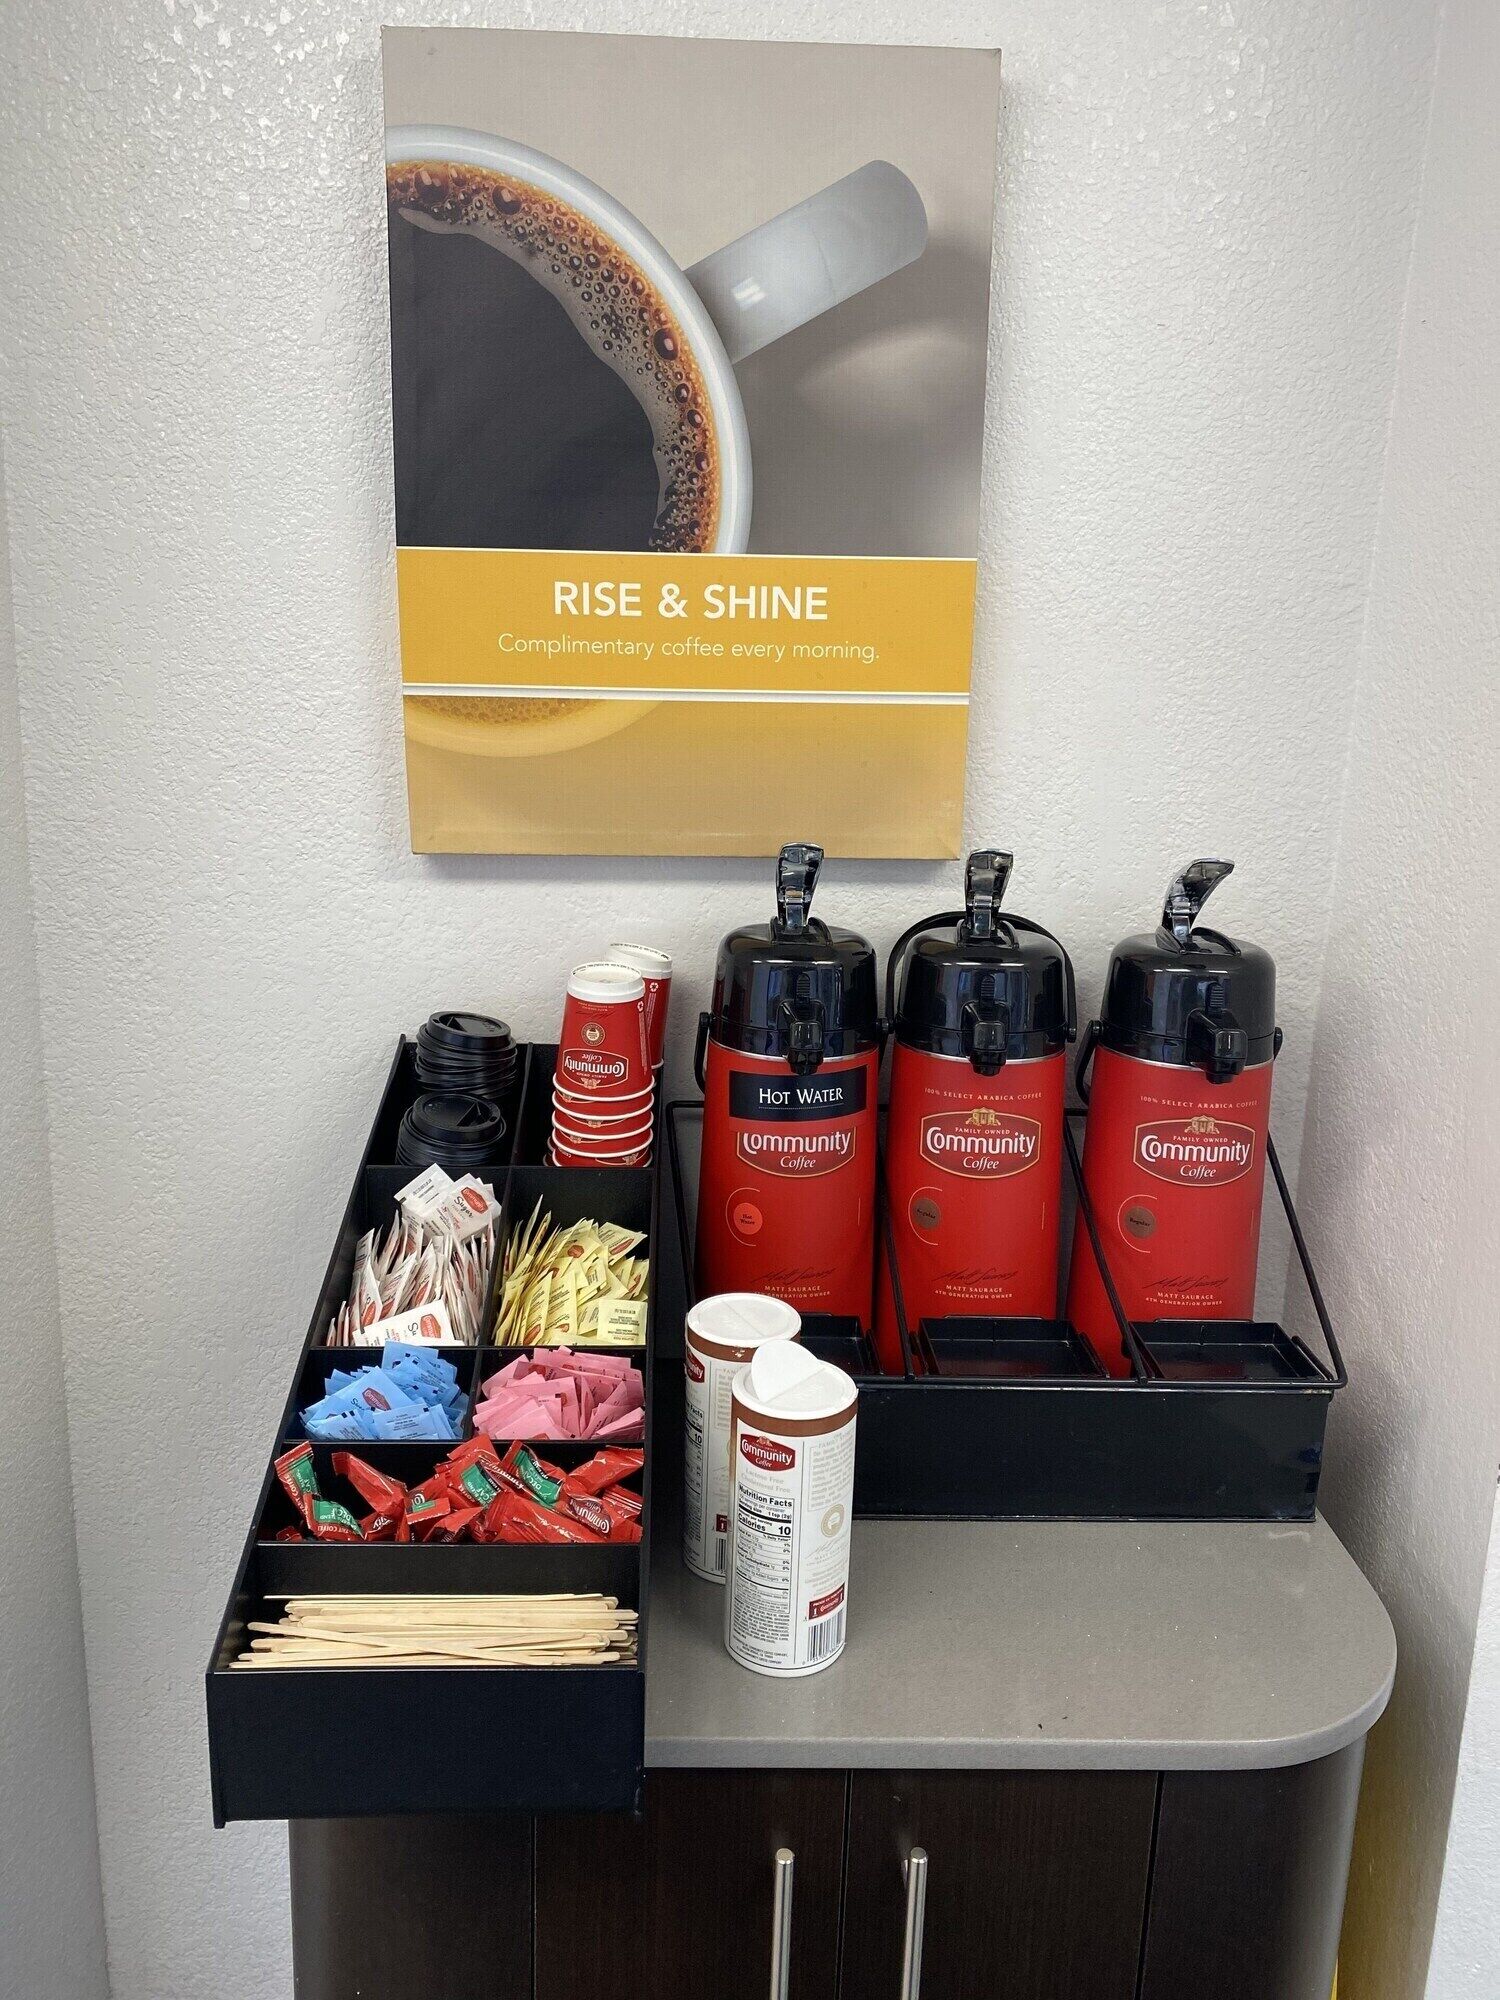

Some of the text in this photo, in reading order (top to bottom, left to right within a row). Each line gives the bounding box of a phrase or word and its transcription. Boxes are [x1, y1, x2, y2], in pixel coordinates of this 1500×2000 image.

[553, 581, 828, 621] RISE & SHINE
[498, 633, 879, 663] Complimentary coffee every morning.
[581, 1053, 603, 1063] Coffee
[564, 1056, 625, 1078] Community
[759, 1087, 844, 1105] HOT WATER
[943, 1091, 973, 1099] SELECT
[1017, 1092, 1042, 1100] COFFEE
[1162, 1100, 1194, 1108] SELECT
[1236, 1100, 1258, 1108] COFFEE
[743, 1131, 851, 1155] Community
[926, 1127, 1036, 1158] Community
[1141, 1135, 1251, 1166] Community
[780, 1155, 816, 1171] Coffee
[963, 1156, 999, 1171] Coffee
[1180, 1164, 1217, 1179] Coffee
[453, 1196, 474, 1218] Sugar
[946, 1284, 967, 1292] MATT
[1157, 1291, 1178, 1299] MATT
[694, 1433, 703, 1444] 10
[741, 1439, 793, 1466] Community
[755, 1457, 773, 1468] Coffee
[769, 1475, 785, 1484] Free
[739, 1485, 793, 1508] Nutrition Facts
[775, 1485, 791, 1493] Free
[739, 1513, 792, 1536] Calories 10
